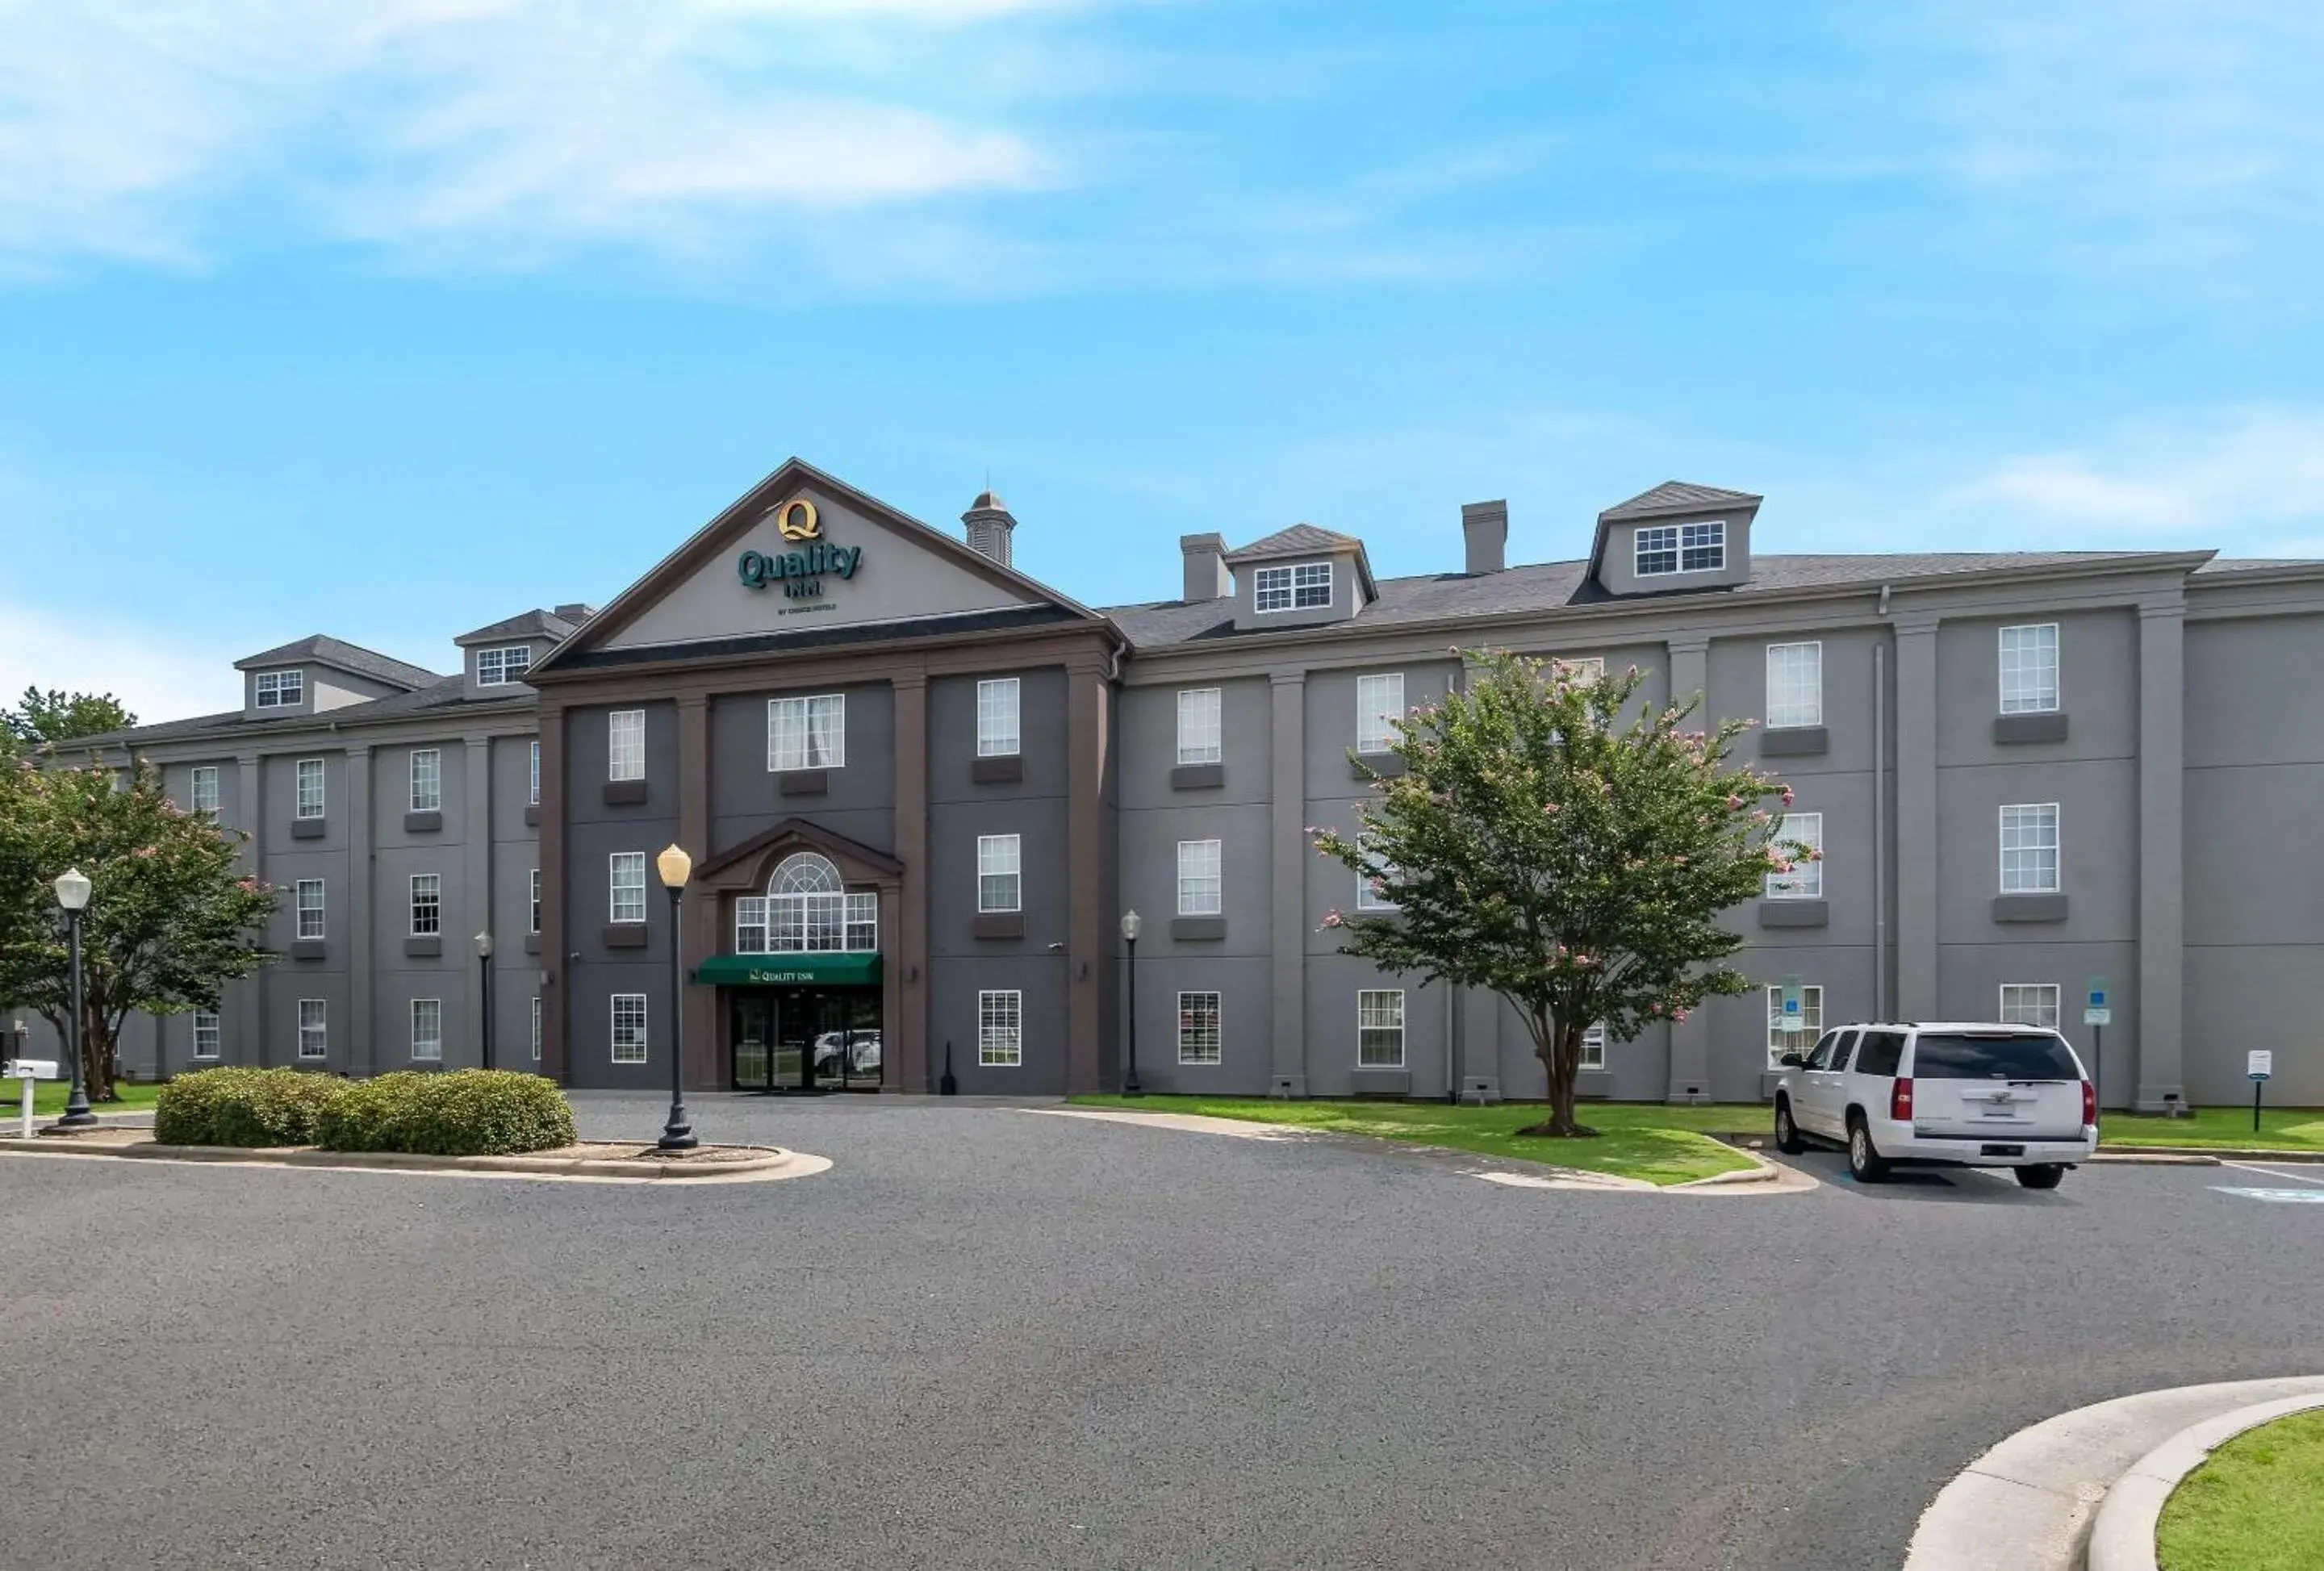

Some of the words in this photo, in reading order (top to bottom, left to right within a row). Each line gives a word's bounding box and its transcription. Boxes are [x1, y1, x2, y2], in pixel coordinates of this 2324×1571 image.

[778, 498, 821, 541] Q
[738, 543, 861, 588] Quality
[784, 580, 821, 598] INN
[762, 971, 796, 982] QUALITY
[796, 971, 814, 981] INN
